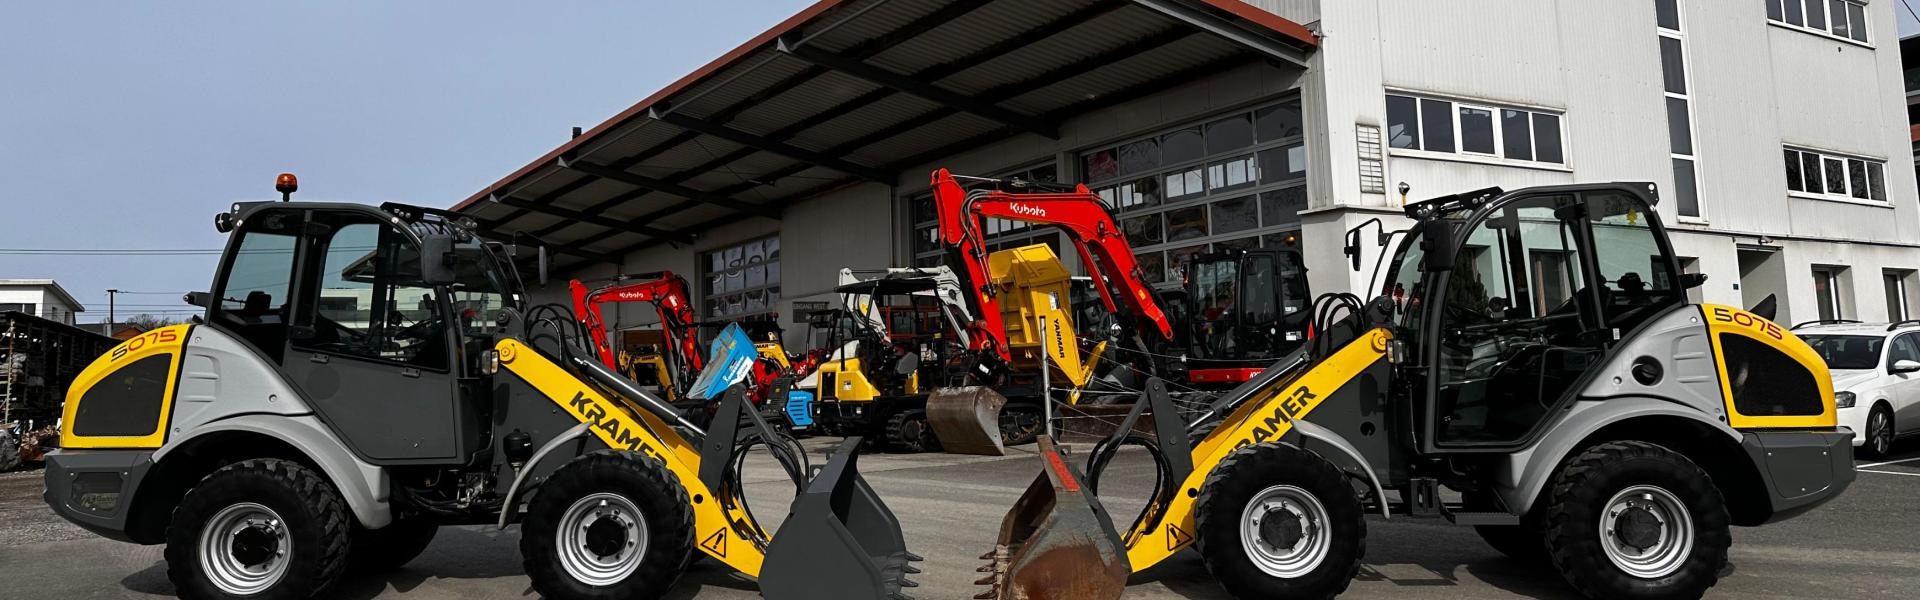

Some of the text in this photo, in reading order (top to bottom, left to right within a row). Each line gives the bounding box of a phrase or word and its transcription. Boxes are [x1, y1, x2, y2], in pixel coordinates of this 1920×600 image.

[1010, 202, 1046, 217] Kubota
[619, 291, 644, 299] Kubota
[1054, 318, 1065, 358] YANMAR
[1714, 308, 1782, 340] 5075
[111, 329, 177, 362] 5075
[1228, 386, 1317, 454] AMER
